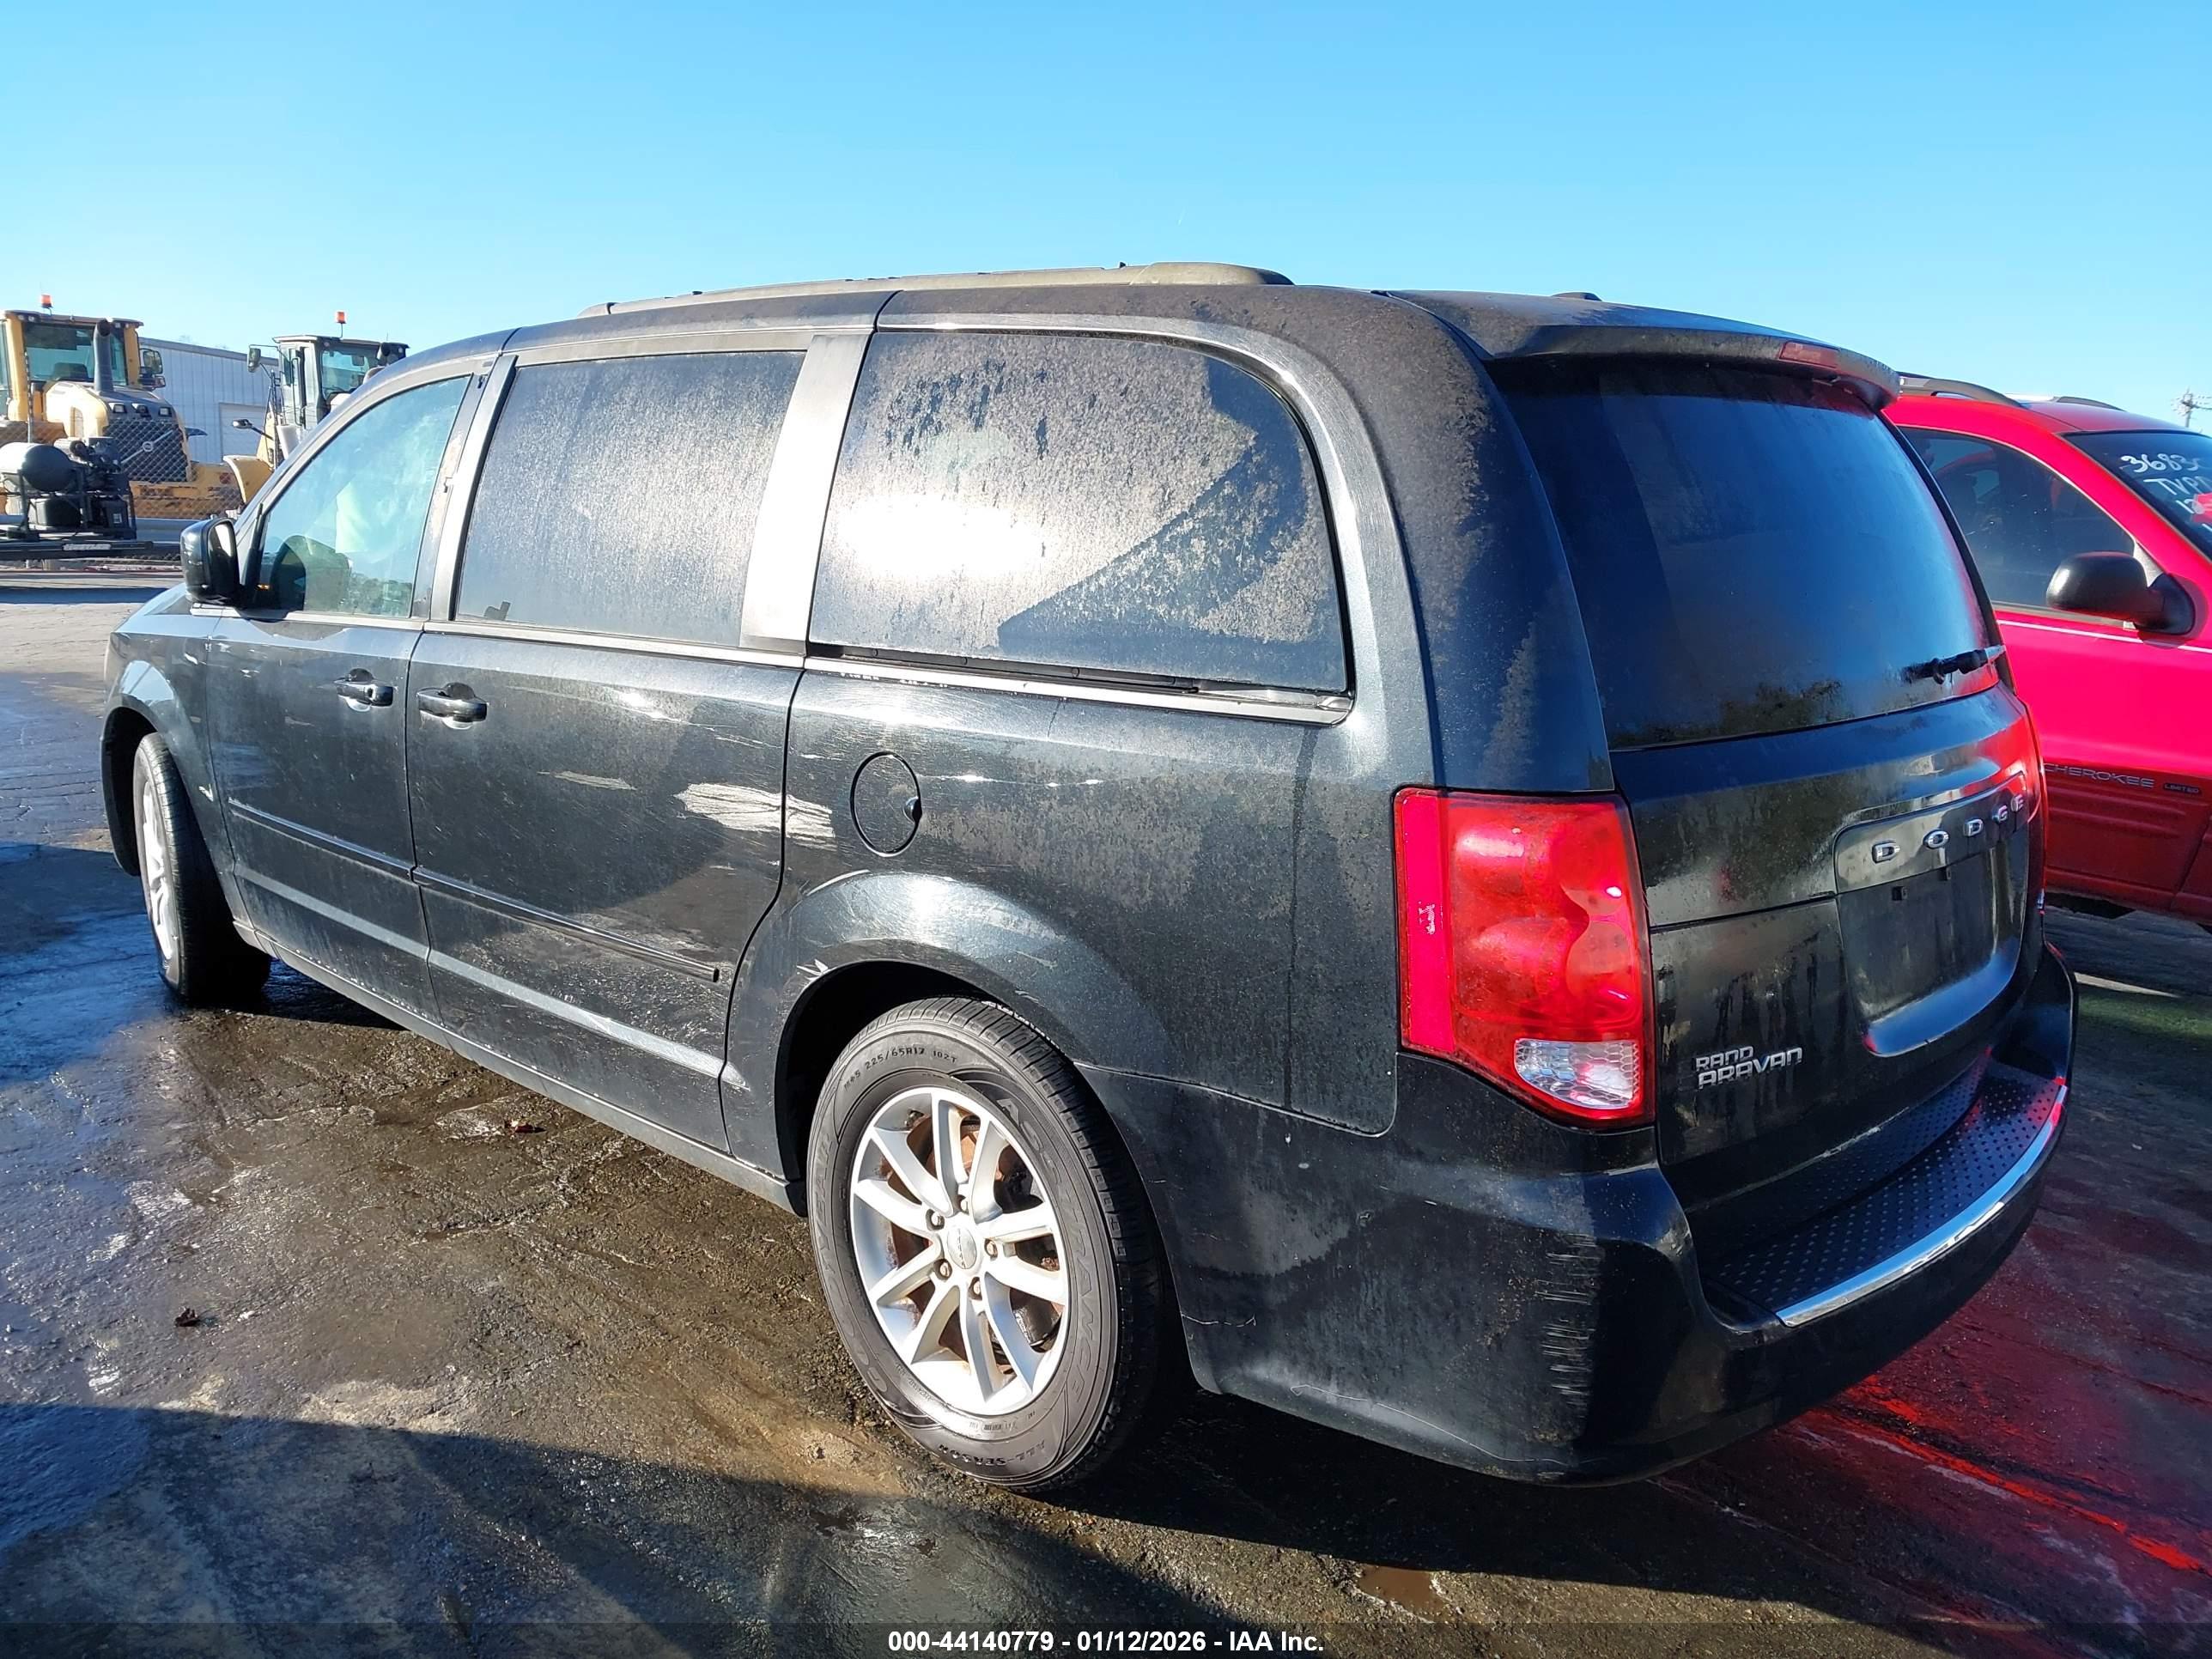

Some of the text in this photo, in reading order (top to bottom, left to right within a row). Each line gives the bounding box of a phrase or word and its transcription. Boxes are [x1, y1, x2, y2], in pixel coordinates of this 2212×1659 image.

[2042, 763, 2155, 788] CHEROKEE
[1872, 793, 2024, 864] DODGE
[865, 1046, 926, 1071] 225/65R17
